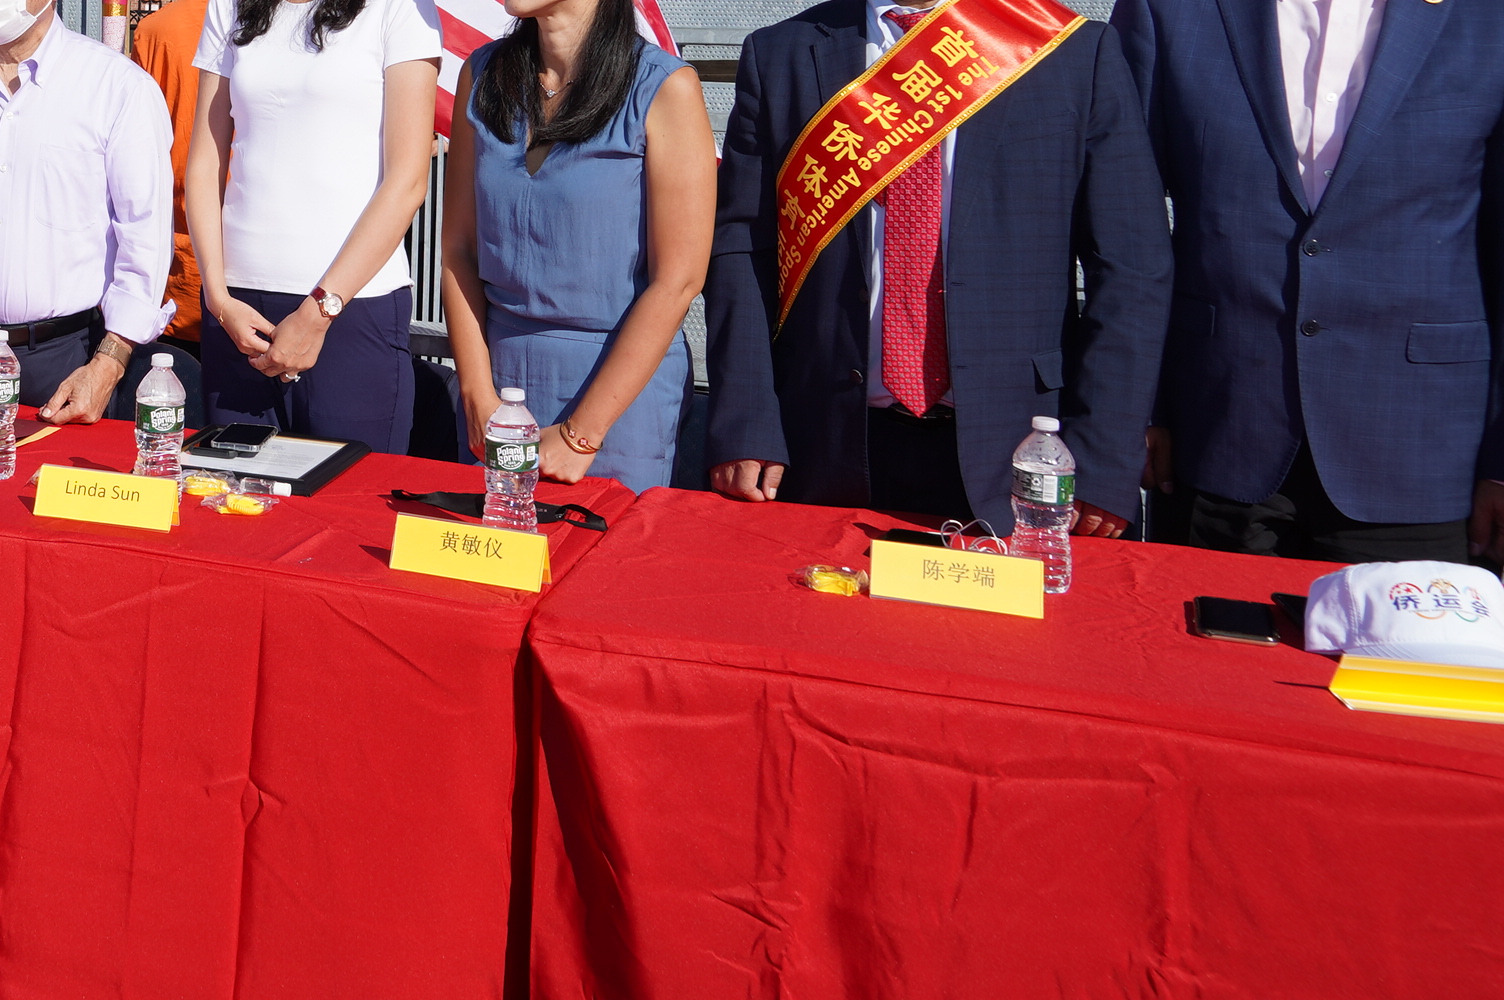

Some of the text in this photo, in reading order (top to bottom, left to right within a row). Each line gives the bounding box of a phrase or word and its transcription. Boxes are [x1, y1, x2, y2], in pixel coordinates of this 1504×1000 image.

[958, 56, 1000, 86] The
[927, 85, 963, 113] 1st
[857, 110, 934, 171] Chinese
[796, 167, 861, 247] American
[65, 480, 141, 502] Linda Sun
[439, 530, 504, 560] 黄敏仪
[922, 558, 996, 589] 陈学端
[1393, 594, 1491, 618] 侨运会
